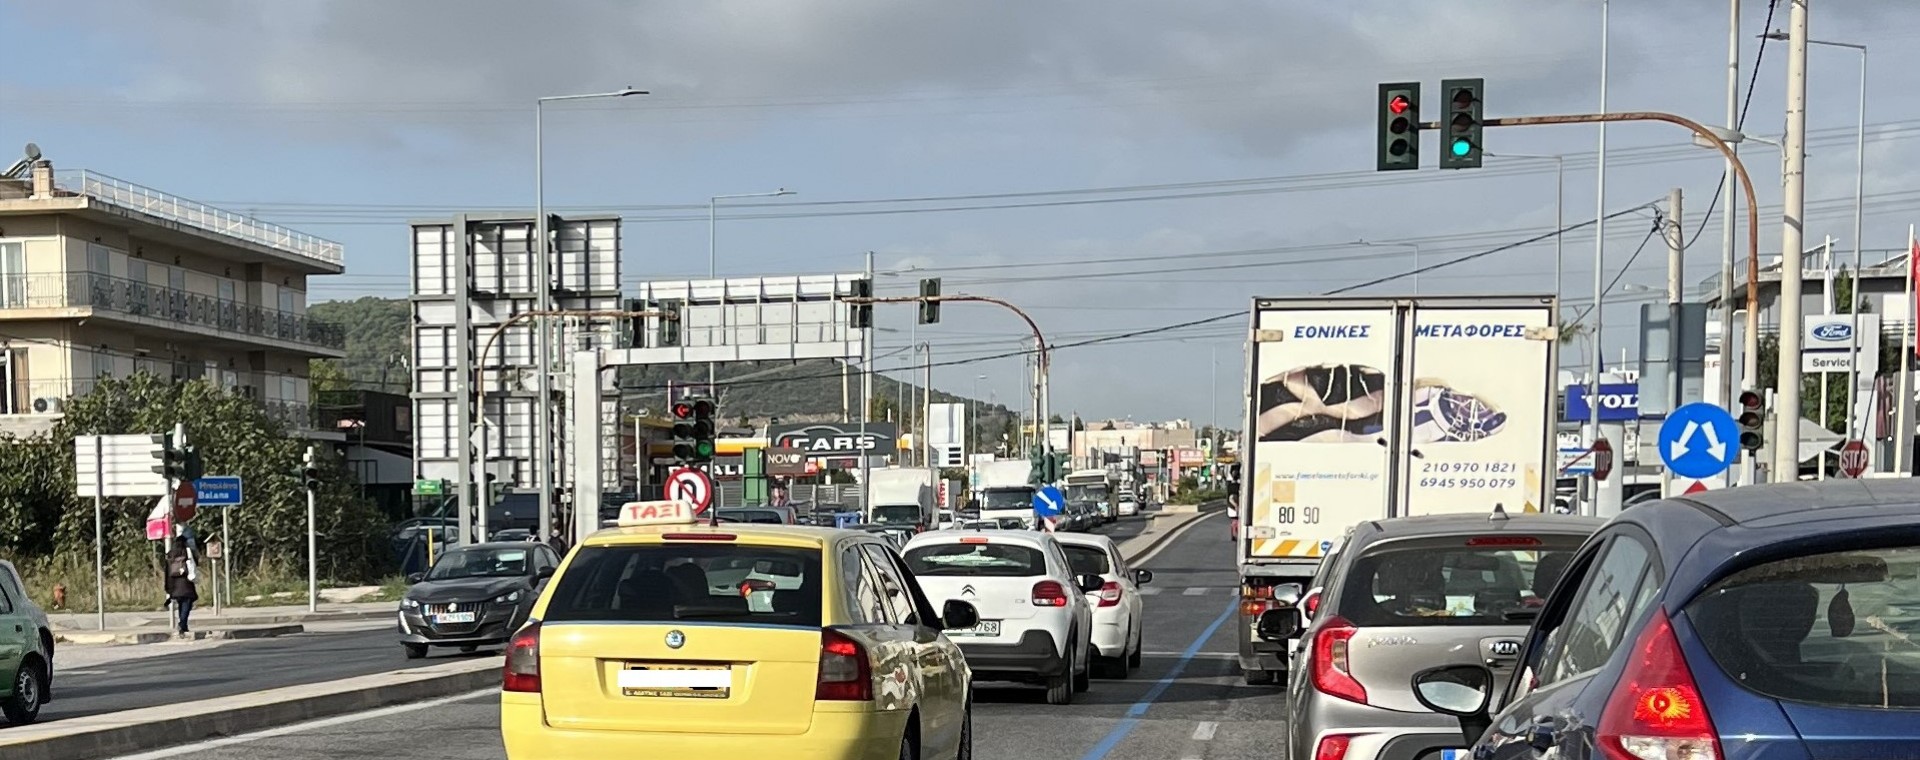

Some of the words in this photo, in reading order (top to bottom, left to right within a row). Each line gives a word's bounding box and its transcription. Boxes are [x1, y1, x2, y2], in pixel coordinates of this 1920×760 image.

[1414, 324, 1526, 338] ΜΕΤΑΦΟΡΕΣ
[1581, 394, 1639, 409] VOL
[1422, 462, 1449, 473] 210
[1453, 462, 1480, 473] 970
[1485, 462, 1516, 473] 1821
[1596, 450, 1612, 471] TOP
[1420, 478, 1456, 488] 6945
[1460, 478, 1486, 488] 950
[1489, 478, 1516, 488] 079
[197, 490, 229, 499] Balana
[628, 504, 680, 520] ΤΑΞΙ
[1278, 506, 1295, 524] 80
[1303, 506, 1320, 524] 90
[1495, 642, 1519, 655] KIA
